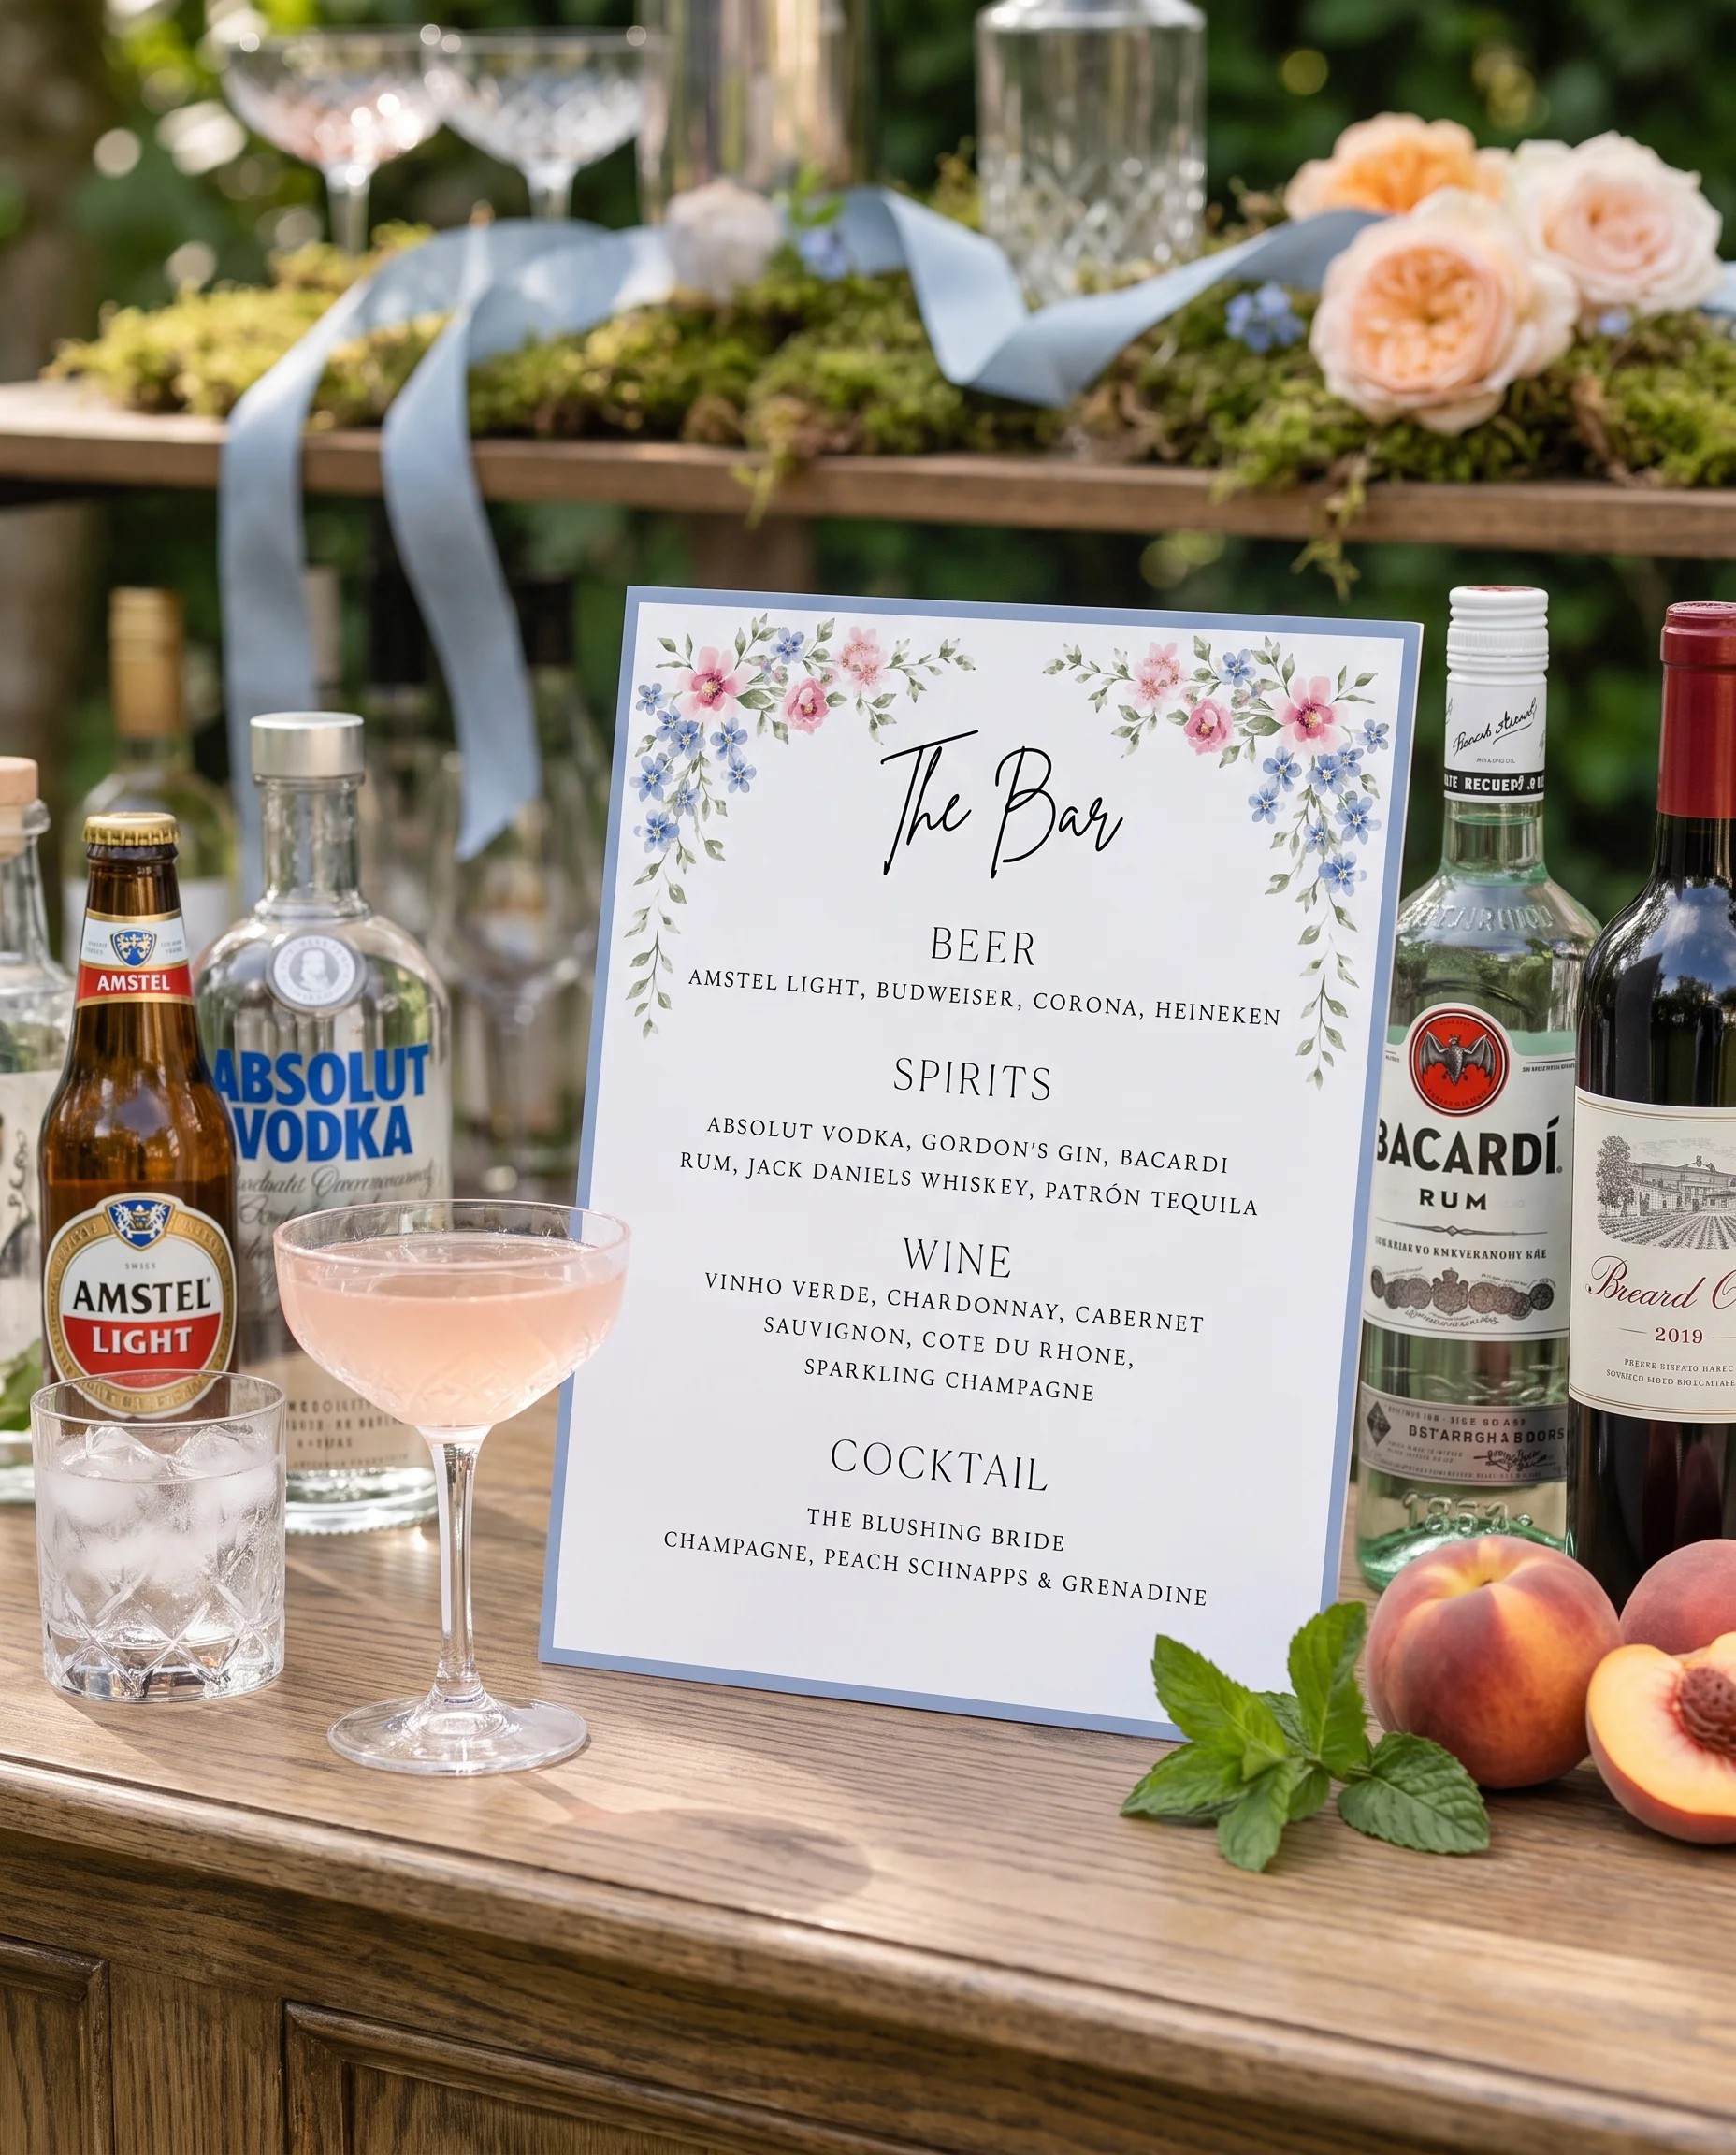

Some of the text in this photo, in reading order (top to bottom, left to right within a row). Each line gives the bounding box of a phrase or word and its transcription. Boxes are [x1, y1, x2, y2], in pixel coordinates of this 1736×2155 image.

[879, 729, 1124, 880] The Bar
[931, 926, 1034, 966] BEER
[96, 974, 171, 991] AMSTEL
[688, 968, 1280, 1026] AMSTEL LIGHT, BUDWEISER, CORONA, HEINEKEN
[213, 1041, 430, 1106] ABSOLUT
[893, 1057, 1051, 1101] SPIRITS
[232, 1104, 413, 1163] VODKA
[706, 1116, 1228, 1174] ABSOLUT VODKA, GORDON'S GIN, BACARDI
[679, 1151, 1259, 1217] RUM, JACK DANIELS WHISKEY, PATRÓN TEQUILA
[1419, 1188, 1487, 1211] RUM
[903, 1237, 1012, 1279] WINE
[73, 1277, 211, 1315] AMSTEL
[704, 1271, 1205, 1334] VINHO VERDE, CHARDONNAY, CABERNET
[92, 1325, 193, 1355] LIGHT
[763, 1316, 1135, 1370] SAUVIGNON, COTE DU RHONE,
[1655, 1326, 1703, 1344] 2019
[803, 1357, 1095, 1402] SPARKLING CHAMPAGNE
[831, 1439, 1049, 1492] COCKTAIL
[806, 1507, 1065, 1553] THE BLUSHING BRIDE
[663, 1530, 1208, 1607] CHAMPAGNE, PEACH SCHNAPPS & GRENADINE
